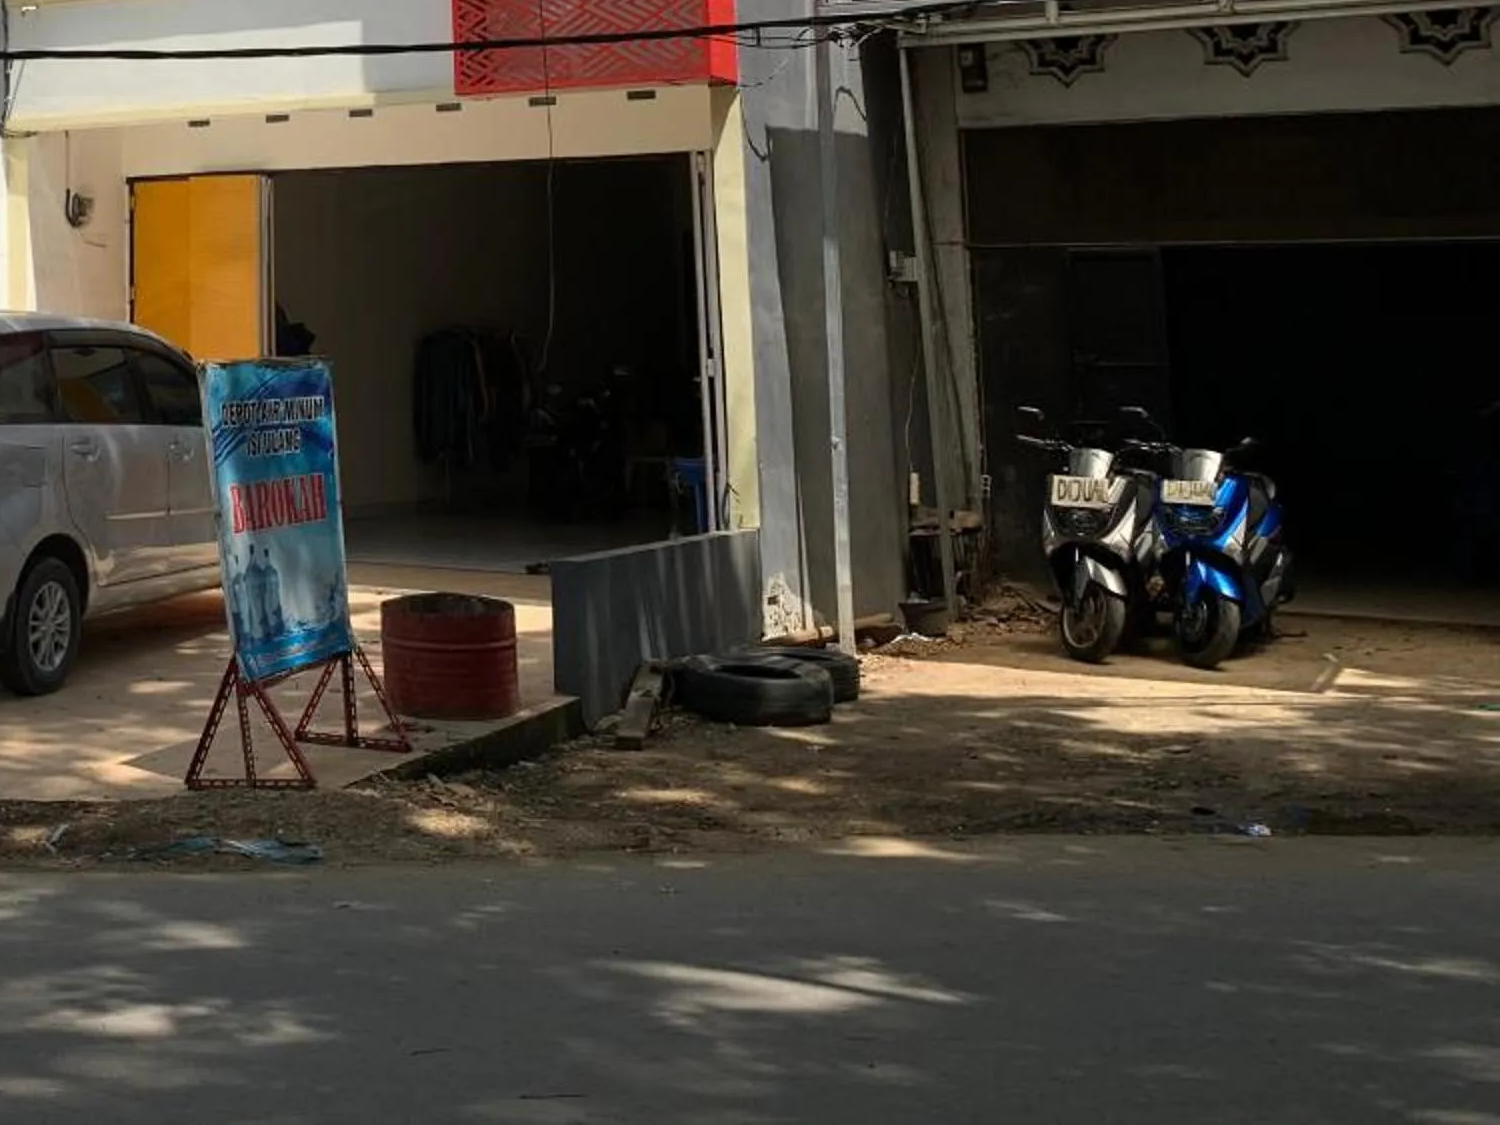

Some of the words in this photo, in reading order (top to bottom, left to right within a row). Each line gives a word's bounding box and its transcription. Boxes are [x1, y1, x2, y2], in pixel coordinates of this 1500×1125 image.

[221, 400, 258, 427] DEPOT
[284, 395, 325, 424] MINUM
[229, 473, 327, 535] BAROKAH
